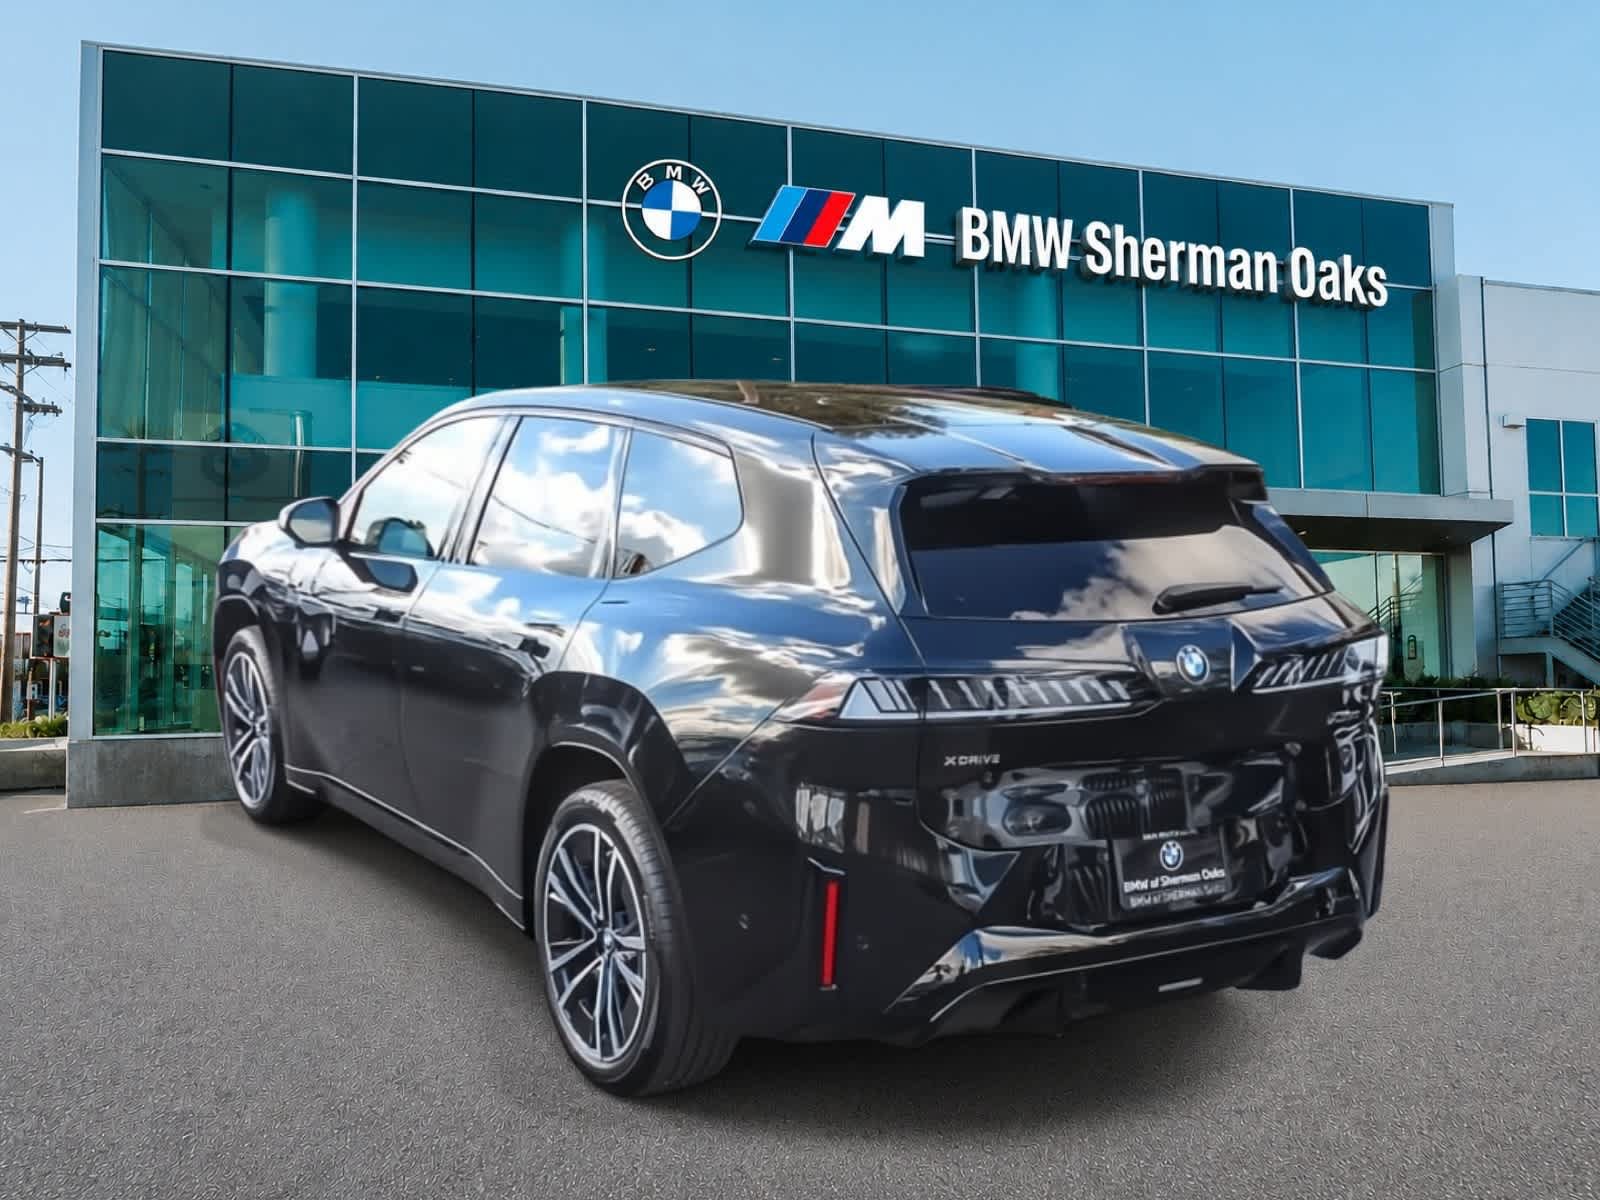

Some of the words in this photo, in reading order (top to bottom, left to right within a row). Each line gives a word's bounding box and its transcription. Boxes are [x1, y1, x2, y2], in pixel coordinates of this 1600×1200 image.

[635, 164, 711, 195] BMW
[960, 206, 1074, 270] BMW
[1084, 220, 1279, 294] Sherman
[1289, 246, 1389, 307] Oaks
[1123, 878, 1149, 893] BMW
[1201, 867, 1226, 880] Oaks
